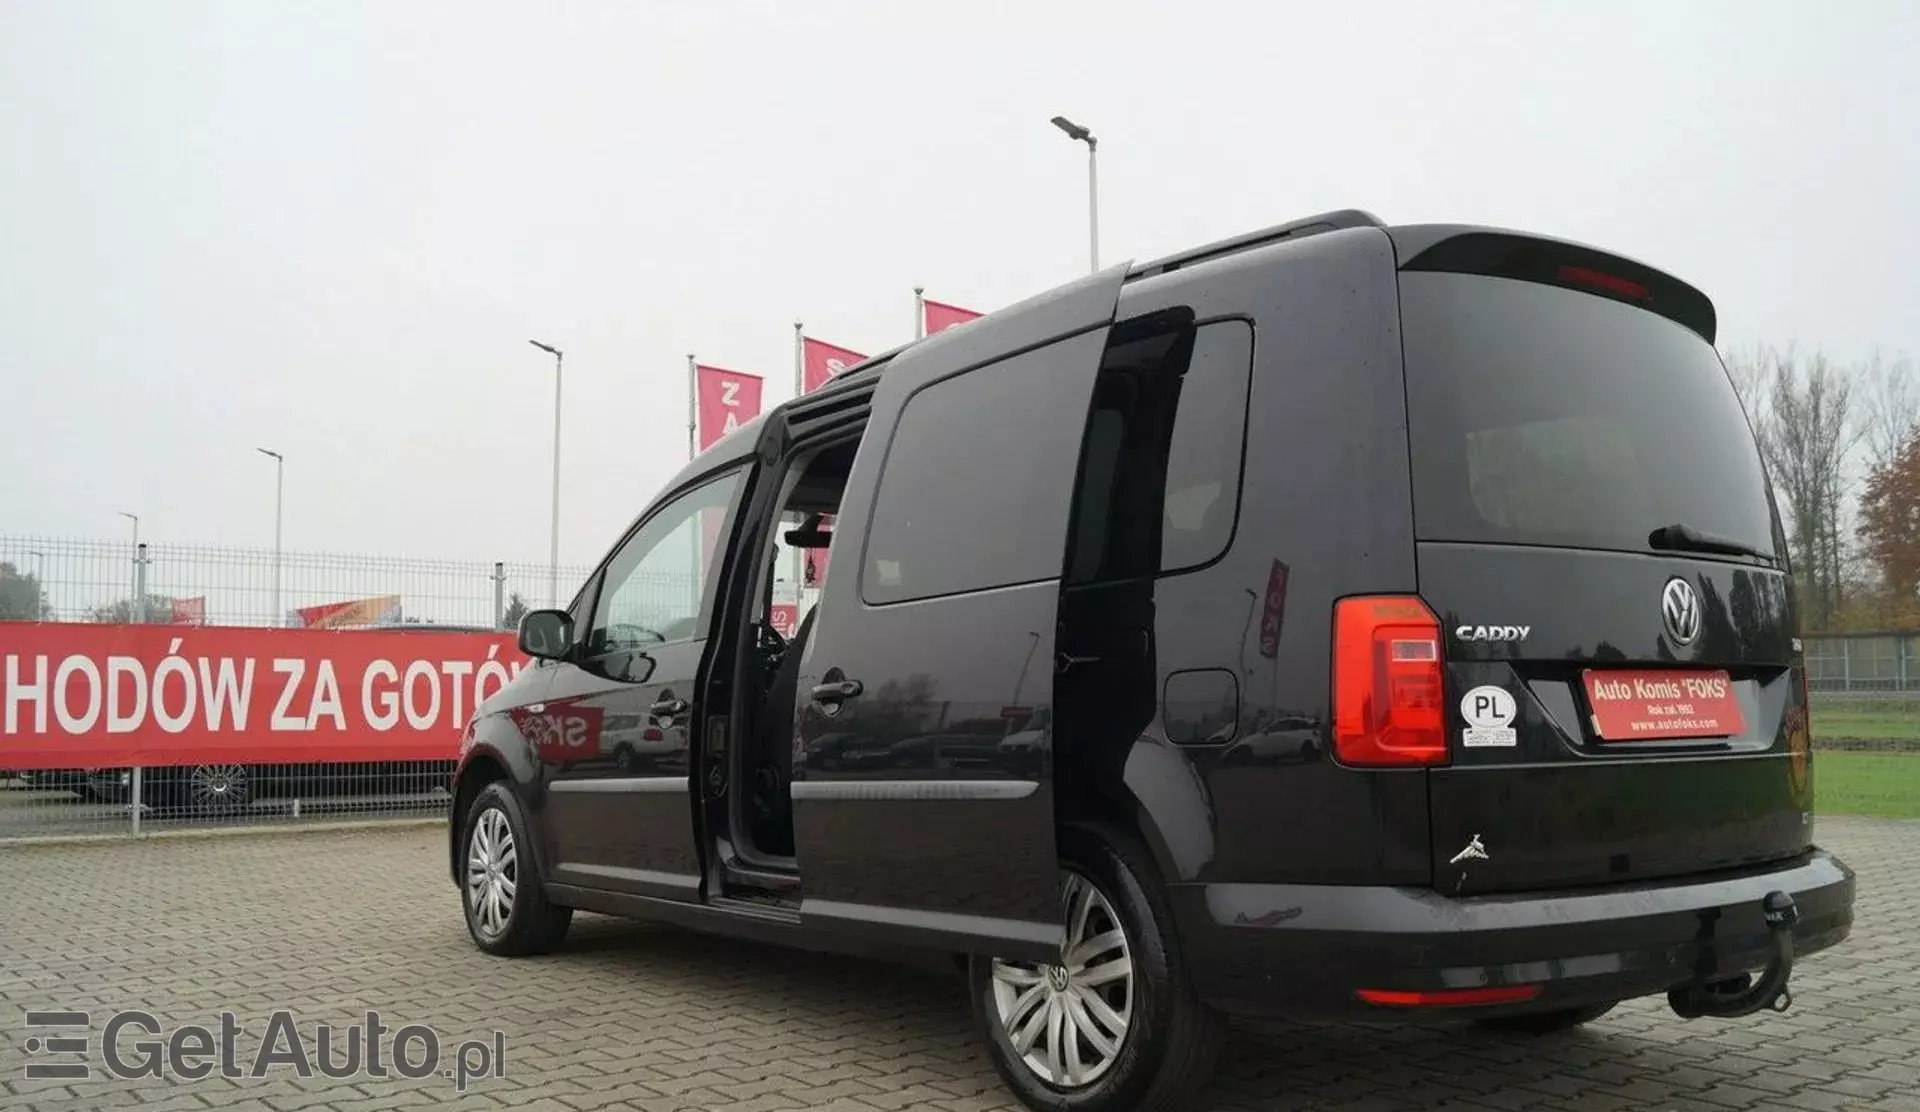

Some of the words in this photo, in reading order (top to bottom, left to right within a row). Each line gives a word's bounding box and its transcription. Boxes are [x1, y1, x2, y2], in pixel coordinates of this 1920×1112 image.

[1455, 624, 1531, 642] CADDY
[4, 637, 256, 735] HODÓW
[270, 658, 347, 731] ZA
[361, 644, 521, 731] GOTÓ
[1593, 679, 1632, 701] Auto
[1633, 678, 1682, 700] Komis
[1474, 695, 1506, 719] PL
